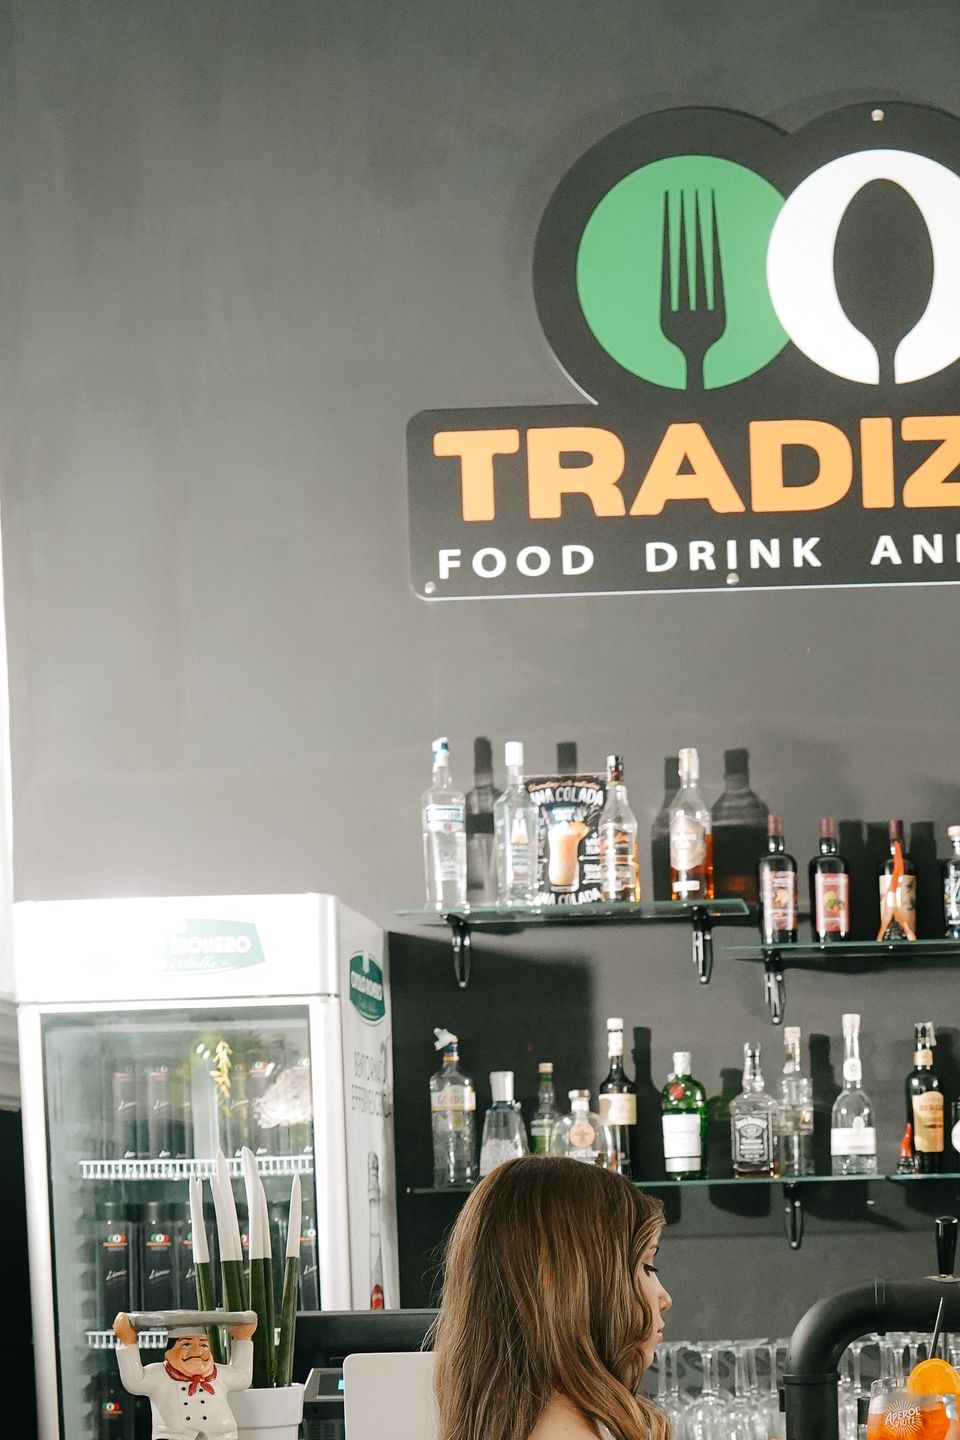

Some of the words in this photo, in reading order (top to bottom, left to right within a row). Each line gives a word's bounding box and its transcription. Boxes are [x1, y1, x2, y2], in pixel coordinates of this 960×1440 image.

[438, 545, 595, 579] FOOD
[645, 537, 822, 572] DRINK
[555, 786, 604, 806] COLADA
[884, 1406, 920, 1428] APEROL
